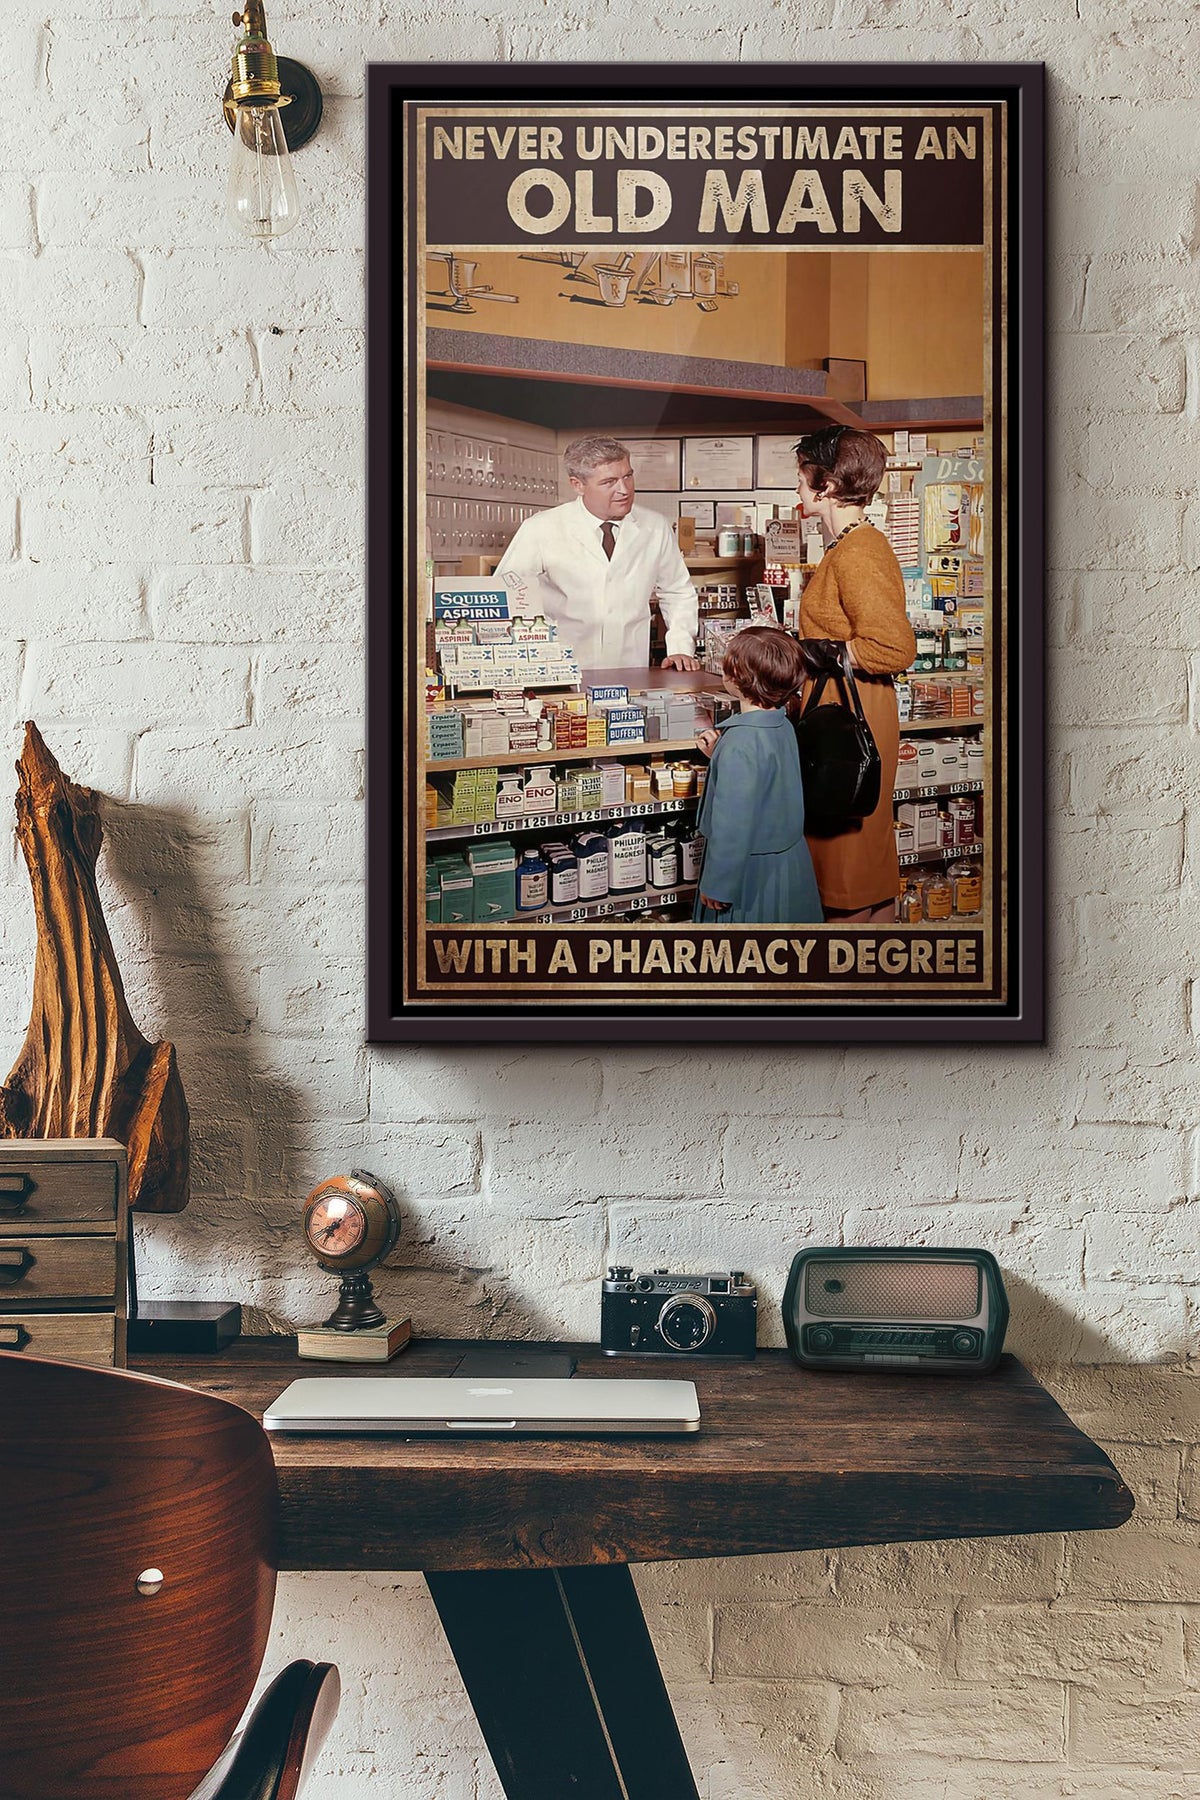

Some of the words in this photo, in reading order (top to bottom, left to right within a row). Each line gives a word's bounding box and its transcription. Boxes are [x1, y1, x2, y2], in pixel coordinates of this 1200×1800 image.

[433, 126, 563, 160] NEVER
[576, 126, 902, 160] UNDERESTIMATE
[914, 126, 977, 160] AN
[507, 168, 672, 235] OLD
[698, 169, 902, 234] MAN
[440, 593, 499, 607] SQUIBB
[443, 608, 501, 619] ASPIRIN
[594, 689, 627, 699] BUFFERIN
[610, 728, 644, 738] BUFFERIN
[526, 788, 555, 798] ENO
[499, 796, 522, 804] ENO
[662, 800, 684, 811] 149
[608, 808, 622, 818] 63
[632, 805, 653, 814] 395
[556, 814, 570, 824] 69
[577, 810, 600, 821] 125
[501, 820, 514, 831] 75
[524, 817, 547, 828] 125
[476, 823, 491, 834] 50
[614, 836, 645, 847] PHILLIPS
[614, 849, 645, 858] MAGNESIA
[586, 856, 607, 865] PHILLIP
[633, 898, 647, 909] 93
[662, 893, 676, 904] 30
[573, 908, 586, 919] 30
[600, 905, 614, 914] 59
[433, 939, 537, 975] WITH
[547, 939, 576, 975] A
[590, 939, 817, 975] PHARMACY
[828, 939, 977, 975] DEGREE
